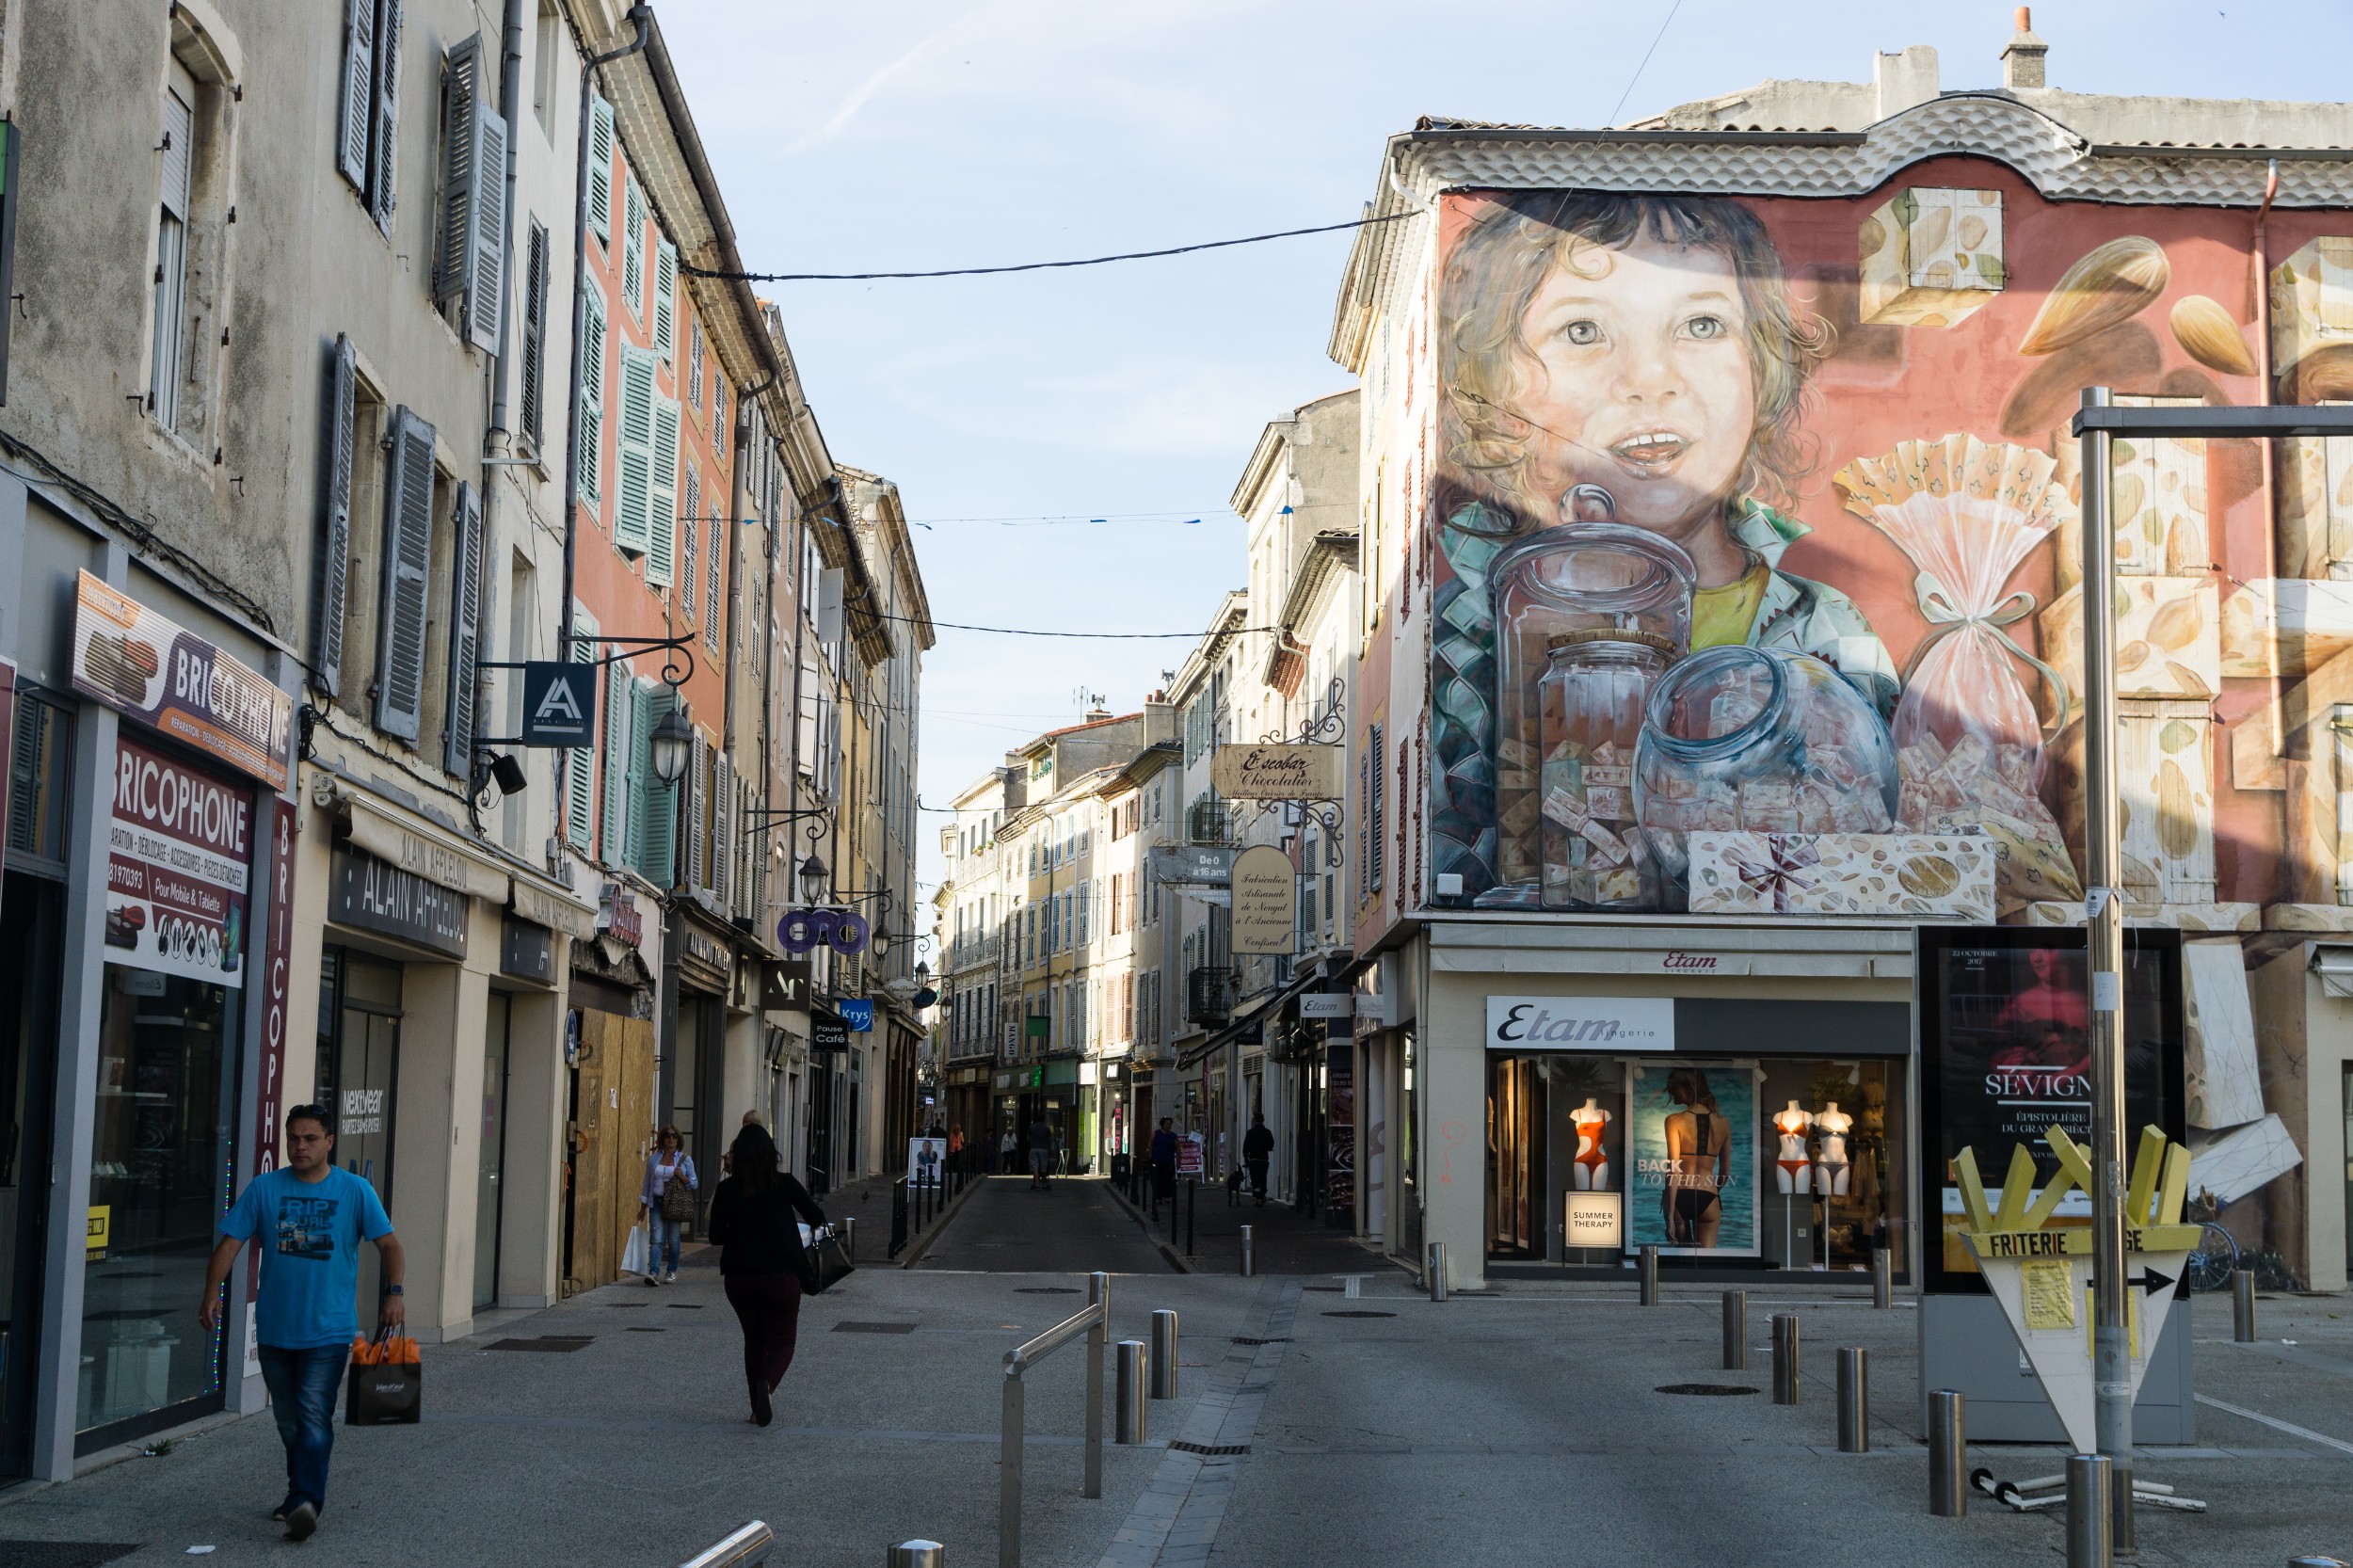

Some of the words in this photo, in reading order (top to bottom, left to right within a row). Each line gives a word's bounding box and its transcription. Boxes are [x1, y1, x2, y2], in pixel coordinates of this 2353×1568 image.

[176, 648, 236, 723] BRICO
[238, 687, 289, 755] PHONE
[1242, 748, 1311, 771] Escobar
[1240, 772, 1313, 787] Chocolatier
[1299, 789, 1324, 797] France
[137, 834, 167, 862] DÉBLOCAGE
[169, 847, 200, 873] ACCESSOIRES
[1199, 856, 1211, 865] De
[429, 846, 467, 889] AFFLELOU
[1193, 867, 1199, 876] à
[1199, 867, 1209, 876] 16
[1210, 869, 1227, 877] ans
[1241, 873, 1289, 884] Fabrication
[362, 853, 411, 922] ALAIN
[1241, 888, 1287, 898] Artisanale
[154, 877, 169, 898] Pour
[169, 882, 190, 904] Mobile
[190, 888, 197, 906] &
[198, 890, 221, 913] Tablette
[1241, 903, 1251, 912] de
[1254, 902, 1288, 915] Nougat
[1243, 936, 1282, 950] Confiseu
[1662, 951, 1718, 968] Etam
[1304, 1000, 1338, 1012] Etam
[841, 1009, 869, 1023] Krys
[1497, 1003, 1621, 1042] Etam
[1601, 1028, 1655, 1038] lingerie
[815, 1033, 846, 1044] Café
[1008, 1025, 1016, 1056] MANGO
[2015, 1111, 2087, 1122] ÉPISTOLIÈRE
[2002, 1124, 2017, 1133] DU
[1638, 1159, 1684, 1174] BACK
[1640, 1174, 1662, 1186] TO
[1666, 1174, 1701, 1186] THE
[1704, 1175, 1739, 1187] SUN
[287, 1200, 329, 1216] RIP
[1574, 1211, 1613, 1220] SUMMER
[1574, 1220, 1613, 1228] THERAPY
[1990, 1232, 2068, 1256] FRITERIE
